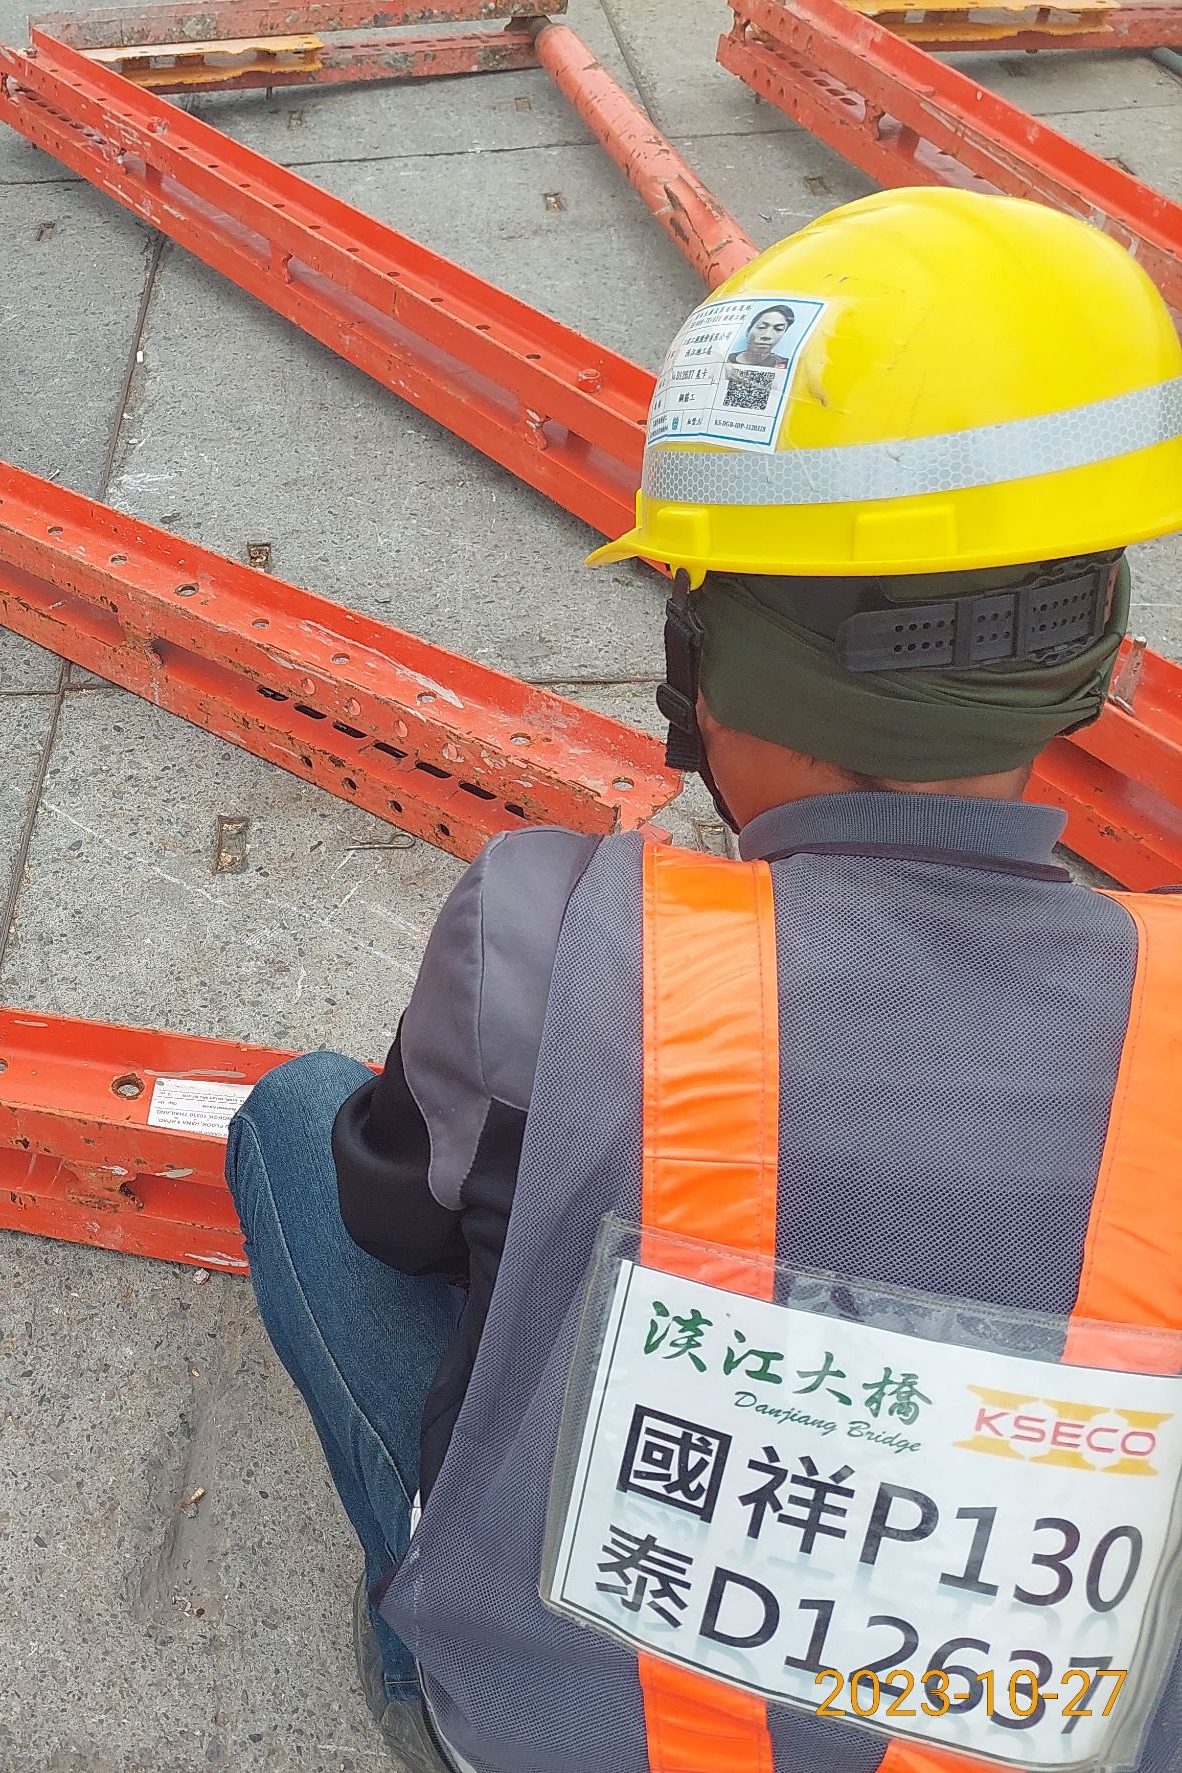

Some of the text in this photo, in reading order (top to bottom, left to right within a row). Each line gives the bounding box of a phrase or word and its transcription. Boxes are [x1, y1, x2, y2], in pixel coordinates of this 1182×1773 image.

[643, 1300, 934, 1427] 淡江大橋
[733, 1391, 922, 1454] Danjiang Bridge
[973, 1406, 1156, 1458] KSECO
